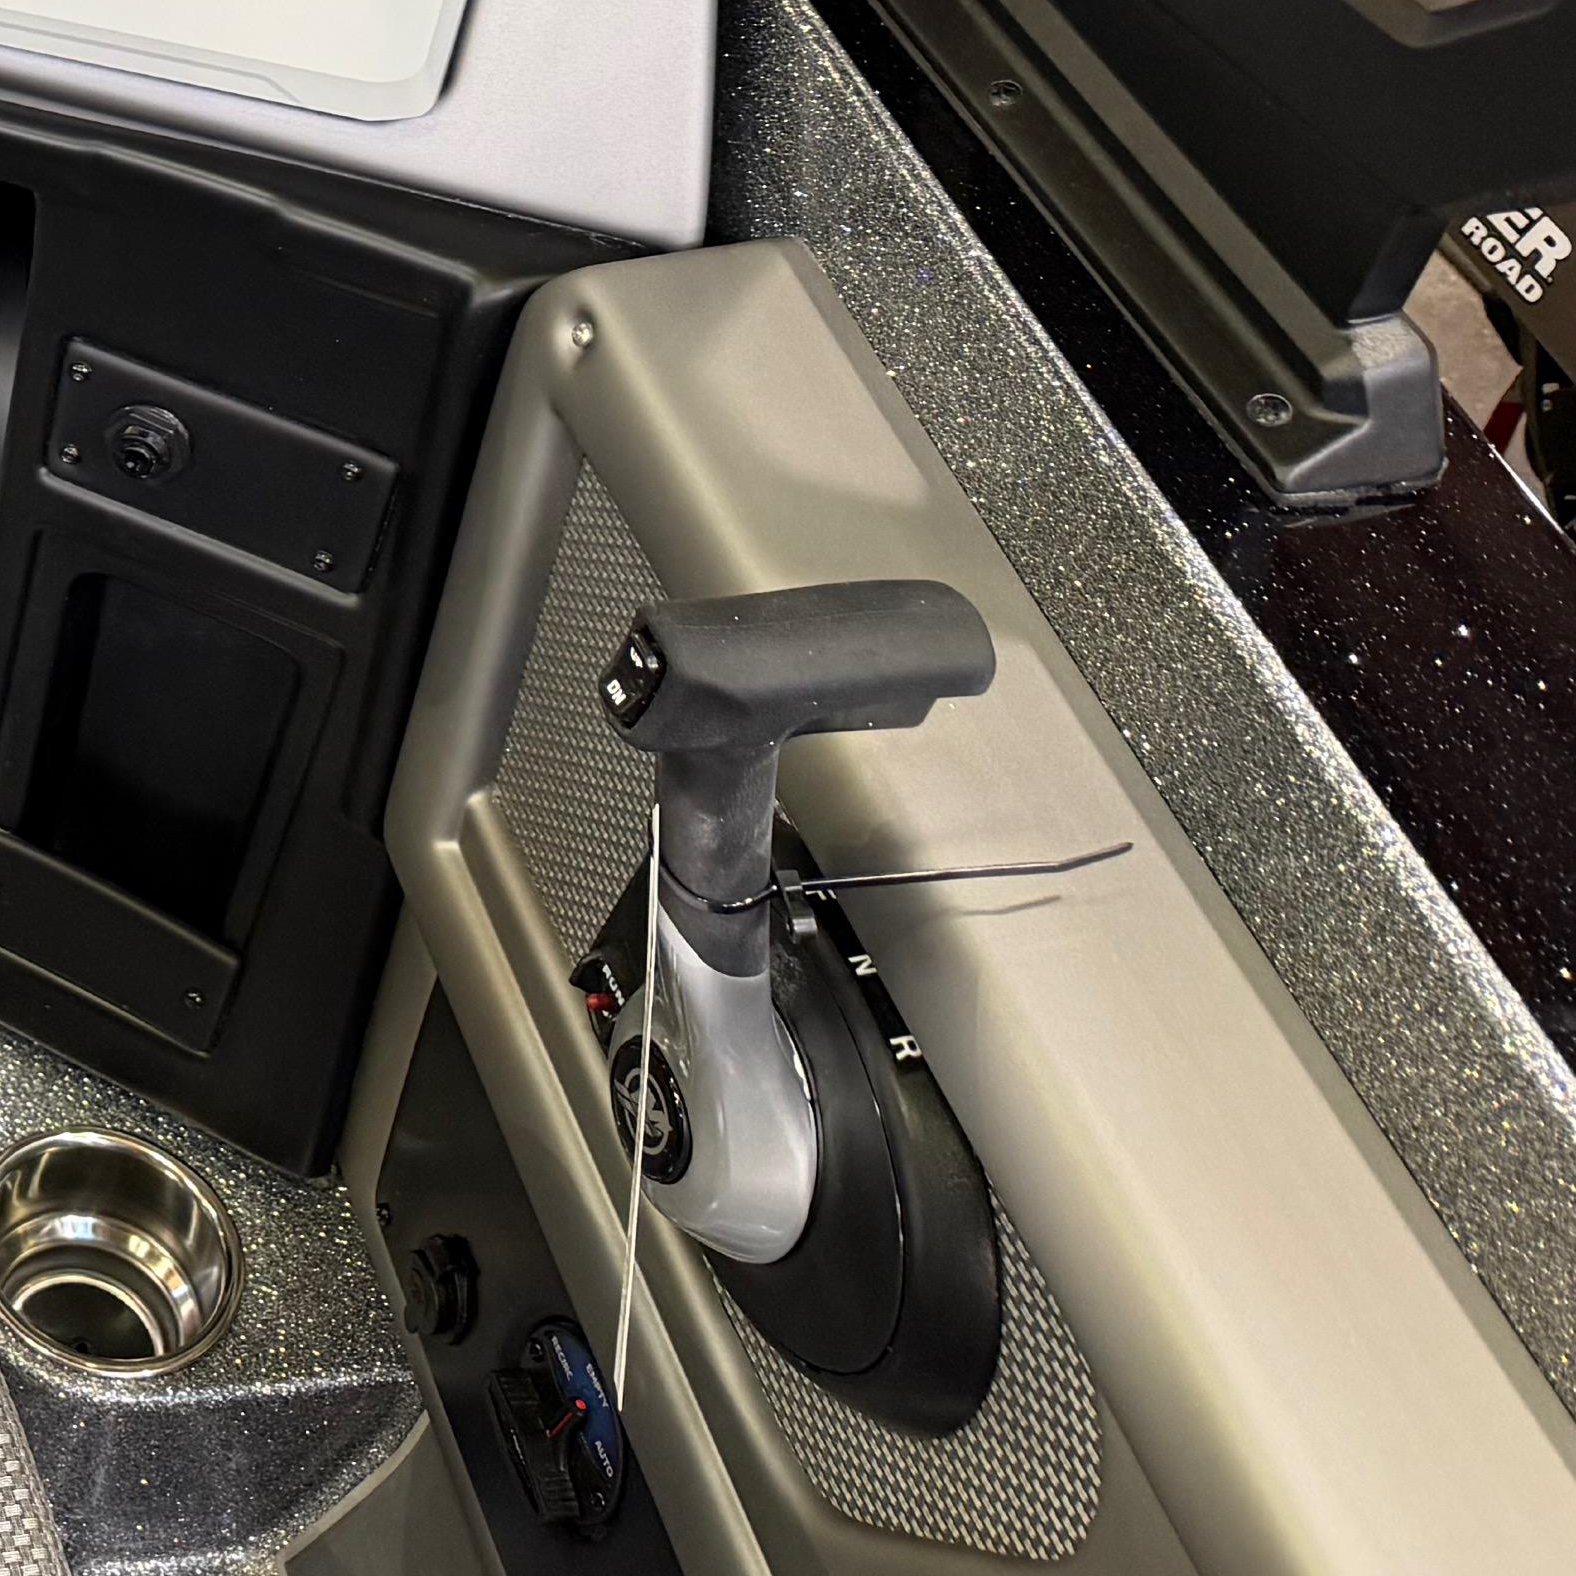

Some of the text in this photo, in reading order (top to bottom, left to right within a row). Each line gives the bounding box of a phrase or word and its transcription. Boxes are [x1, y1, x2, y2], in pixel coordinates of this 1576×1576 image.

[1460, 216, 1545, 304] ROAD
[601, 963, 626, 1007] RUN
[847, 953, 878, 976] N
[889, 1035, 923, 1061] R
[585, 1362, 609, 1409] EMPTY
[594, 1439, 614, 1478] AUTO
